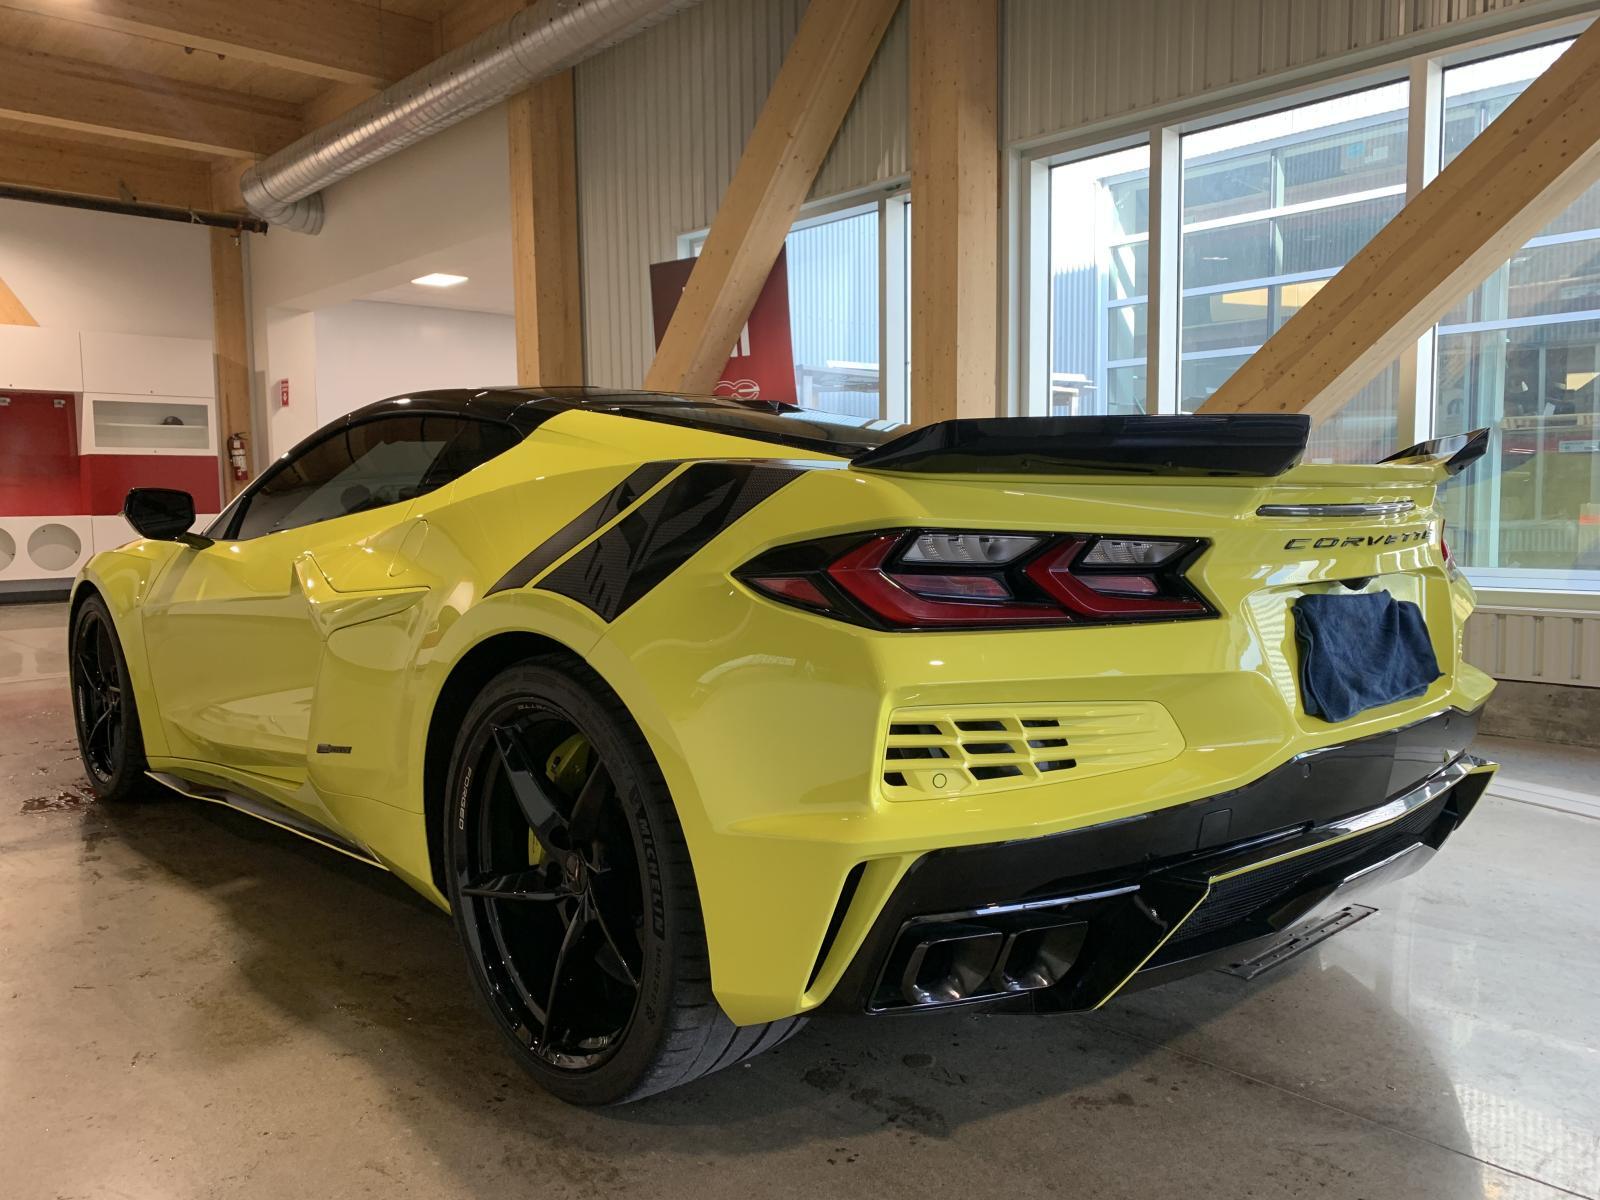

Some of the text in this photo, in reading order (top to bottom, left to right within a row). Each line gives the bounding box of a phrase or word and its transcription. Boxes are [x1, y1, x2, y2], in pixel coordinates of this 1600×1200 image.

[1284, 530, 1432, 550] CORVETTE
[459, 766, 472, 830] FORGED
[638, 816, 665, 936] MICHELIN
